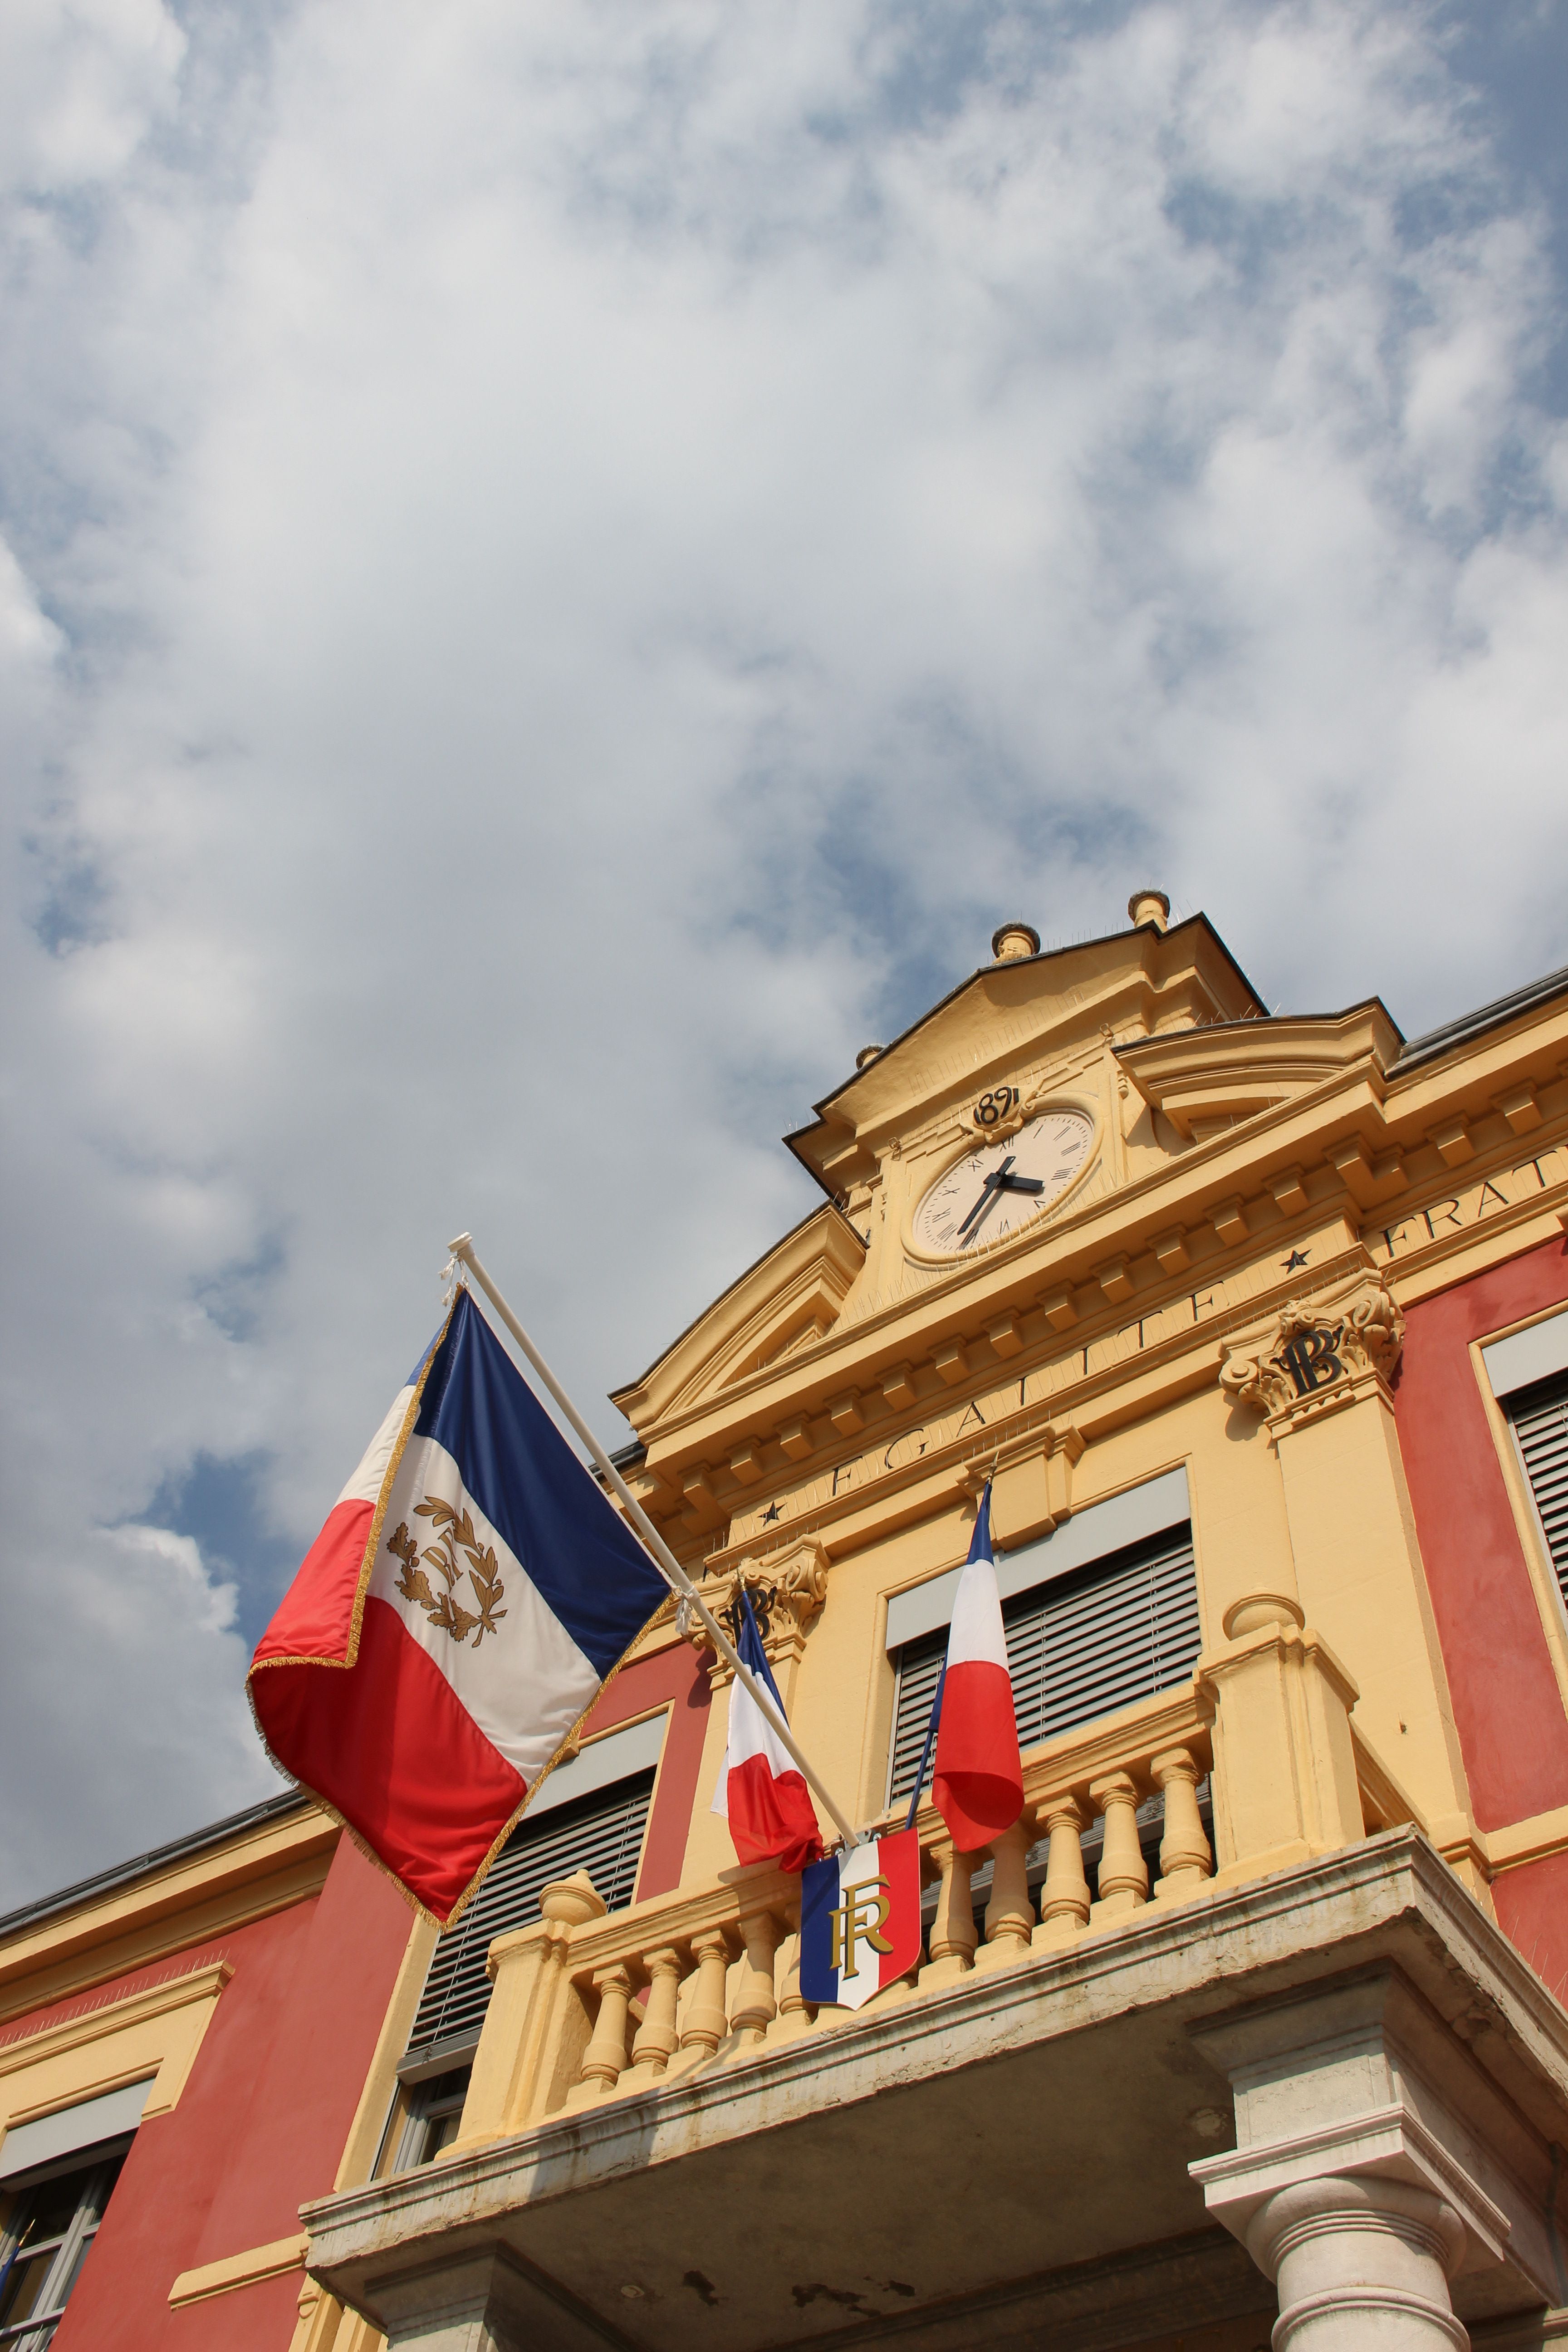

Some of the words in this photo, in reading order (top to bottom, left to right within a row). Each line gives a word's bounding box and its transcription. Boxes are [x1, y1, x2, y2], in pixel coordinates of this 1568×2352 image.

[973, 1086, 1019, 1124] 1891
[1053, 1126, 1071, 1141] II
[1000, 1135, 1014, 1152] XII
[1060, 1142, 1081, 1156] III
[967, 1159, 984, 1172] XI
[941, 1187, 961, 1196] X
[1378, 1143, 1568, 1258] FRAT
[931, 1207, 951, 1223] IX
